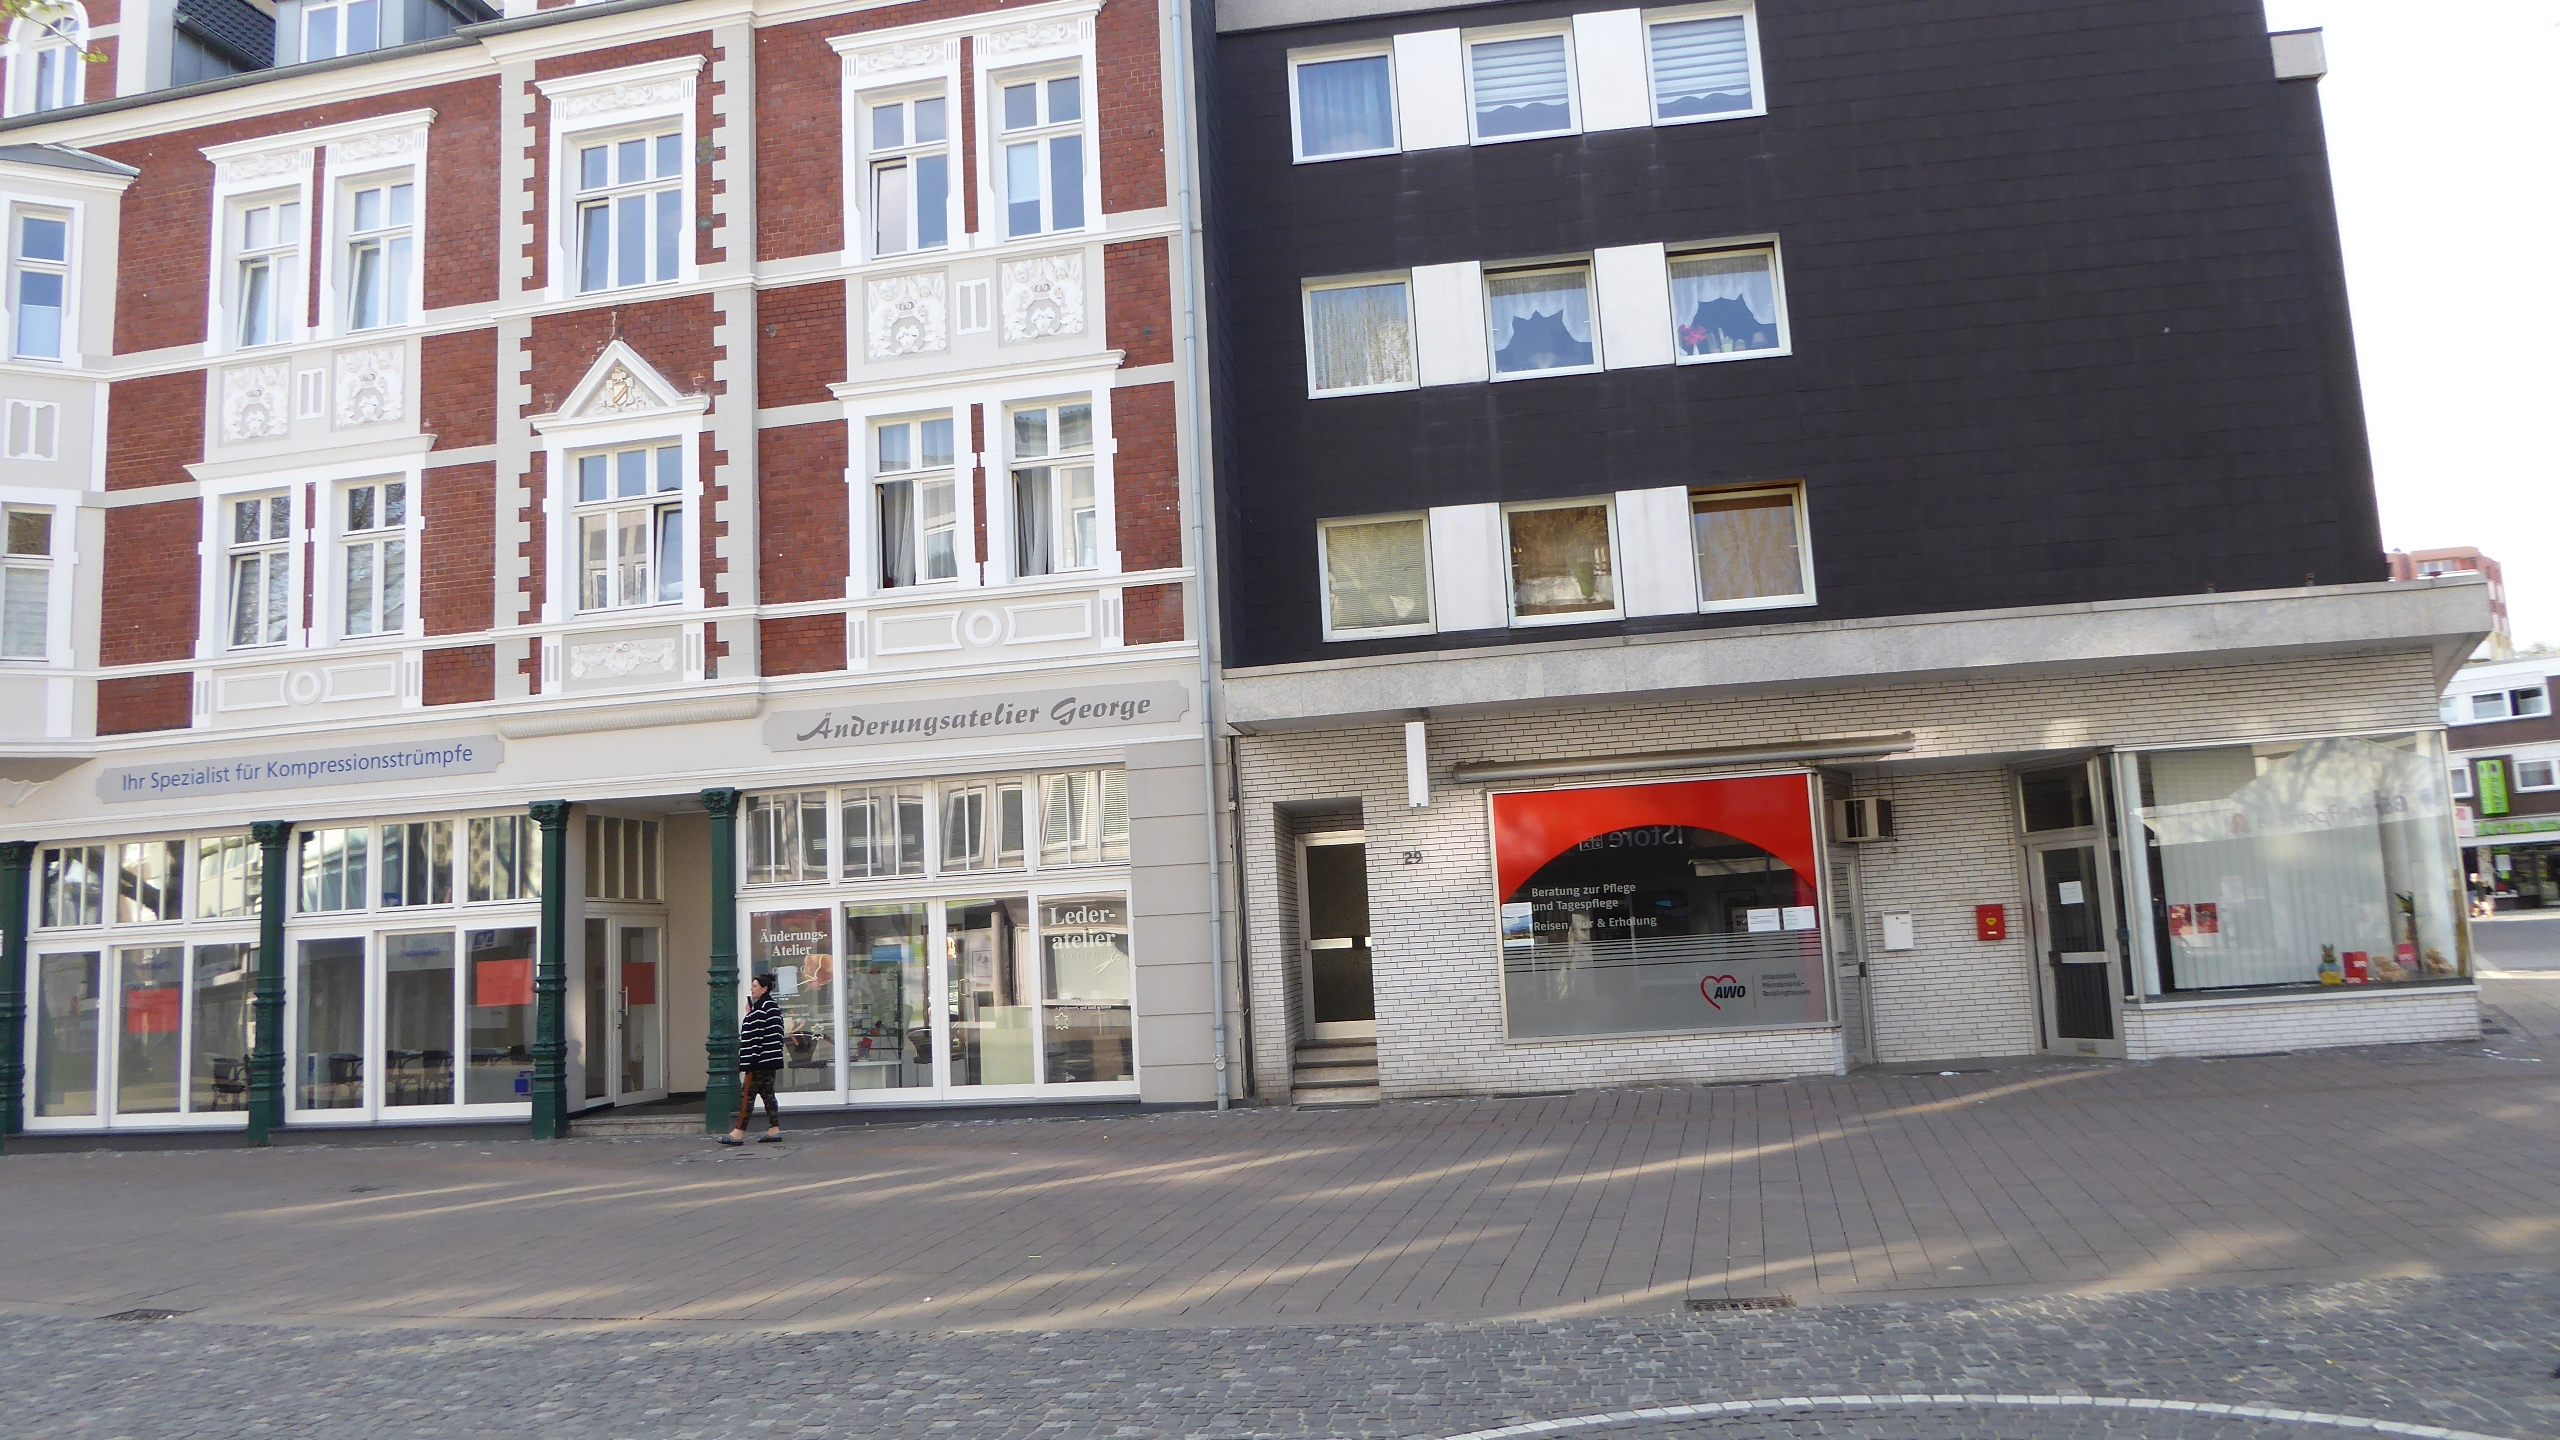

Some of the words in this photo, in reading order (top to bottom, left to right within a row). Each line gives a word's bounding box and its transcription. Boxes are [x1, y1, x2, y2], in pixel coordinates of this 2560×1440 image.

[797, 703, 1039, 741] Änderungsatelier
[1051, 697, 1151, 726] George
[122, 773, 145, 791] Ihr
[150, 765, 230, 792] Spezialist
[236, 763, 261, 781] für
[267, 744, 473, 779] Kompressionsstrümpfe
[1404, 851, 1423, 865] 29
[1531, 887, 1580, 898] Beratung
[1583, 886, 1600, 895] zur
[1603, 883, 1636, 895] Pflege
[1532, 900, 1554, 912] und
[1555, 899, 1619, 912] Tagespflege
[1049, 906, 1116, 925] Leder-
[1597, 918, 1606, 928] &
[1609, 917, 1658, 927] Erholung
[760, 928, 828, 943] Änderungs-
[1052, 929, 1116, 950] atelier
[771, 944, 812, 957] Atelier
[1714, 985, 1746, 999] AWO
